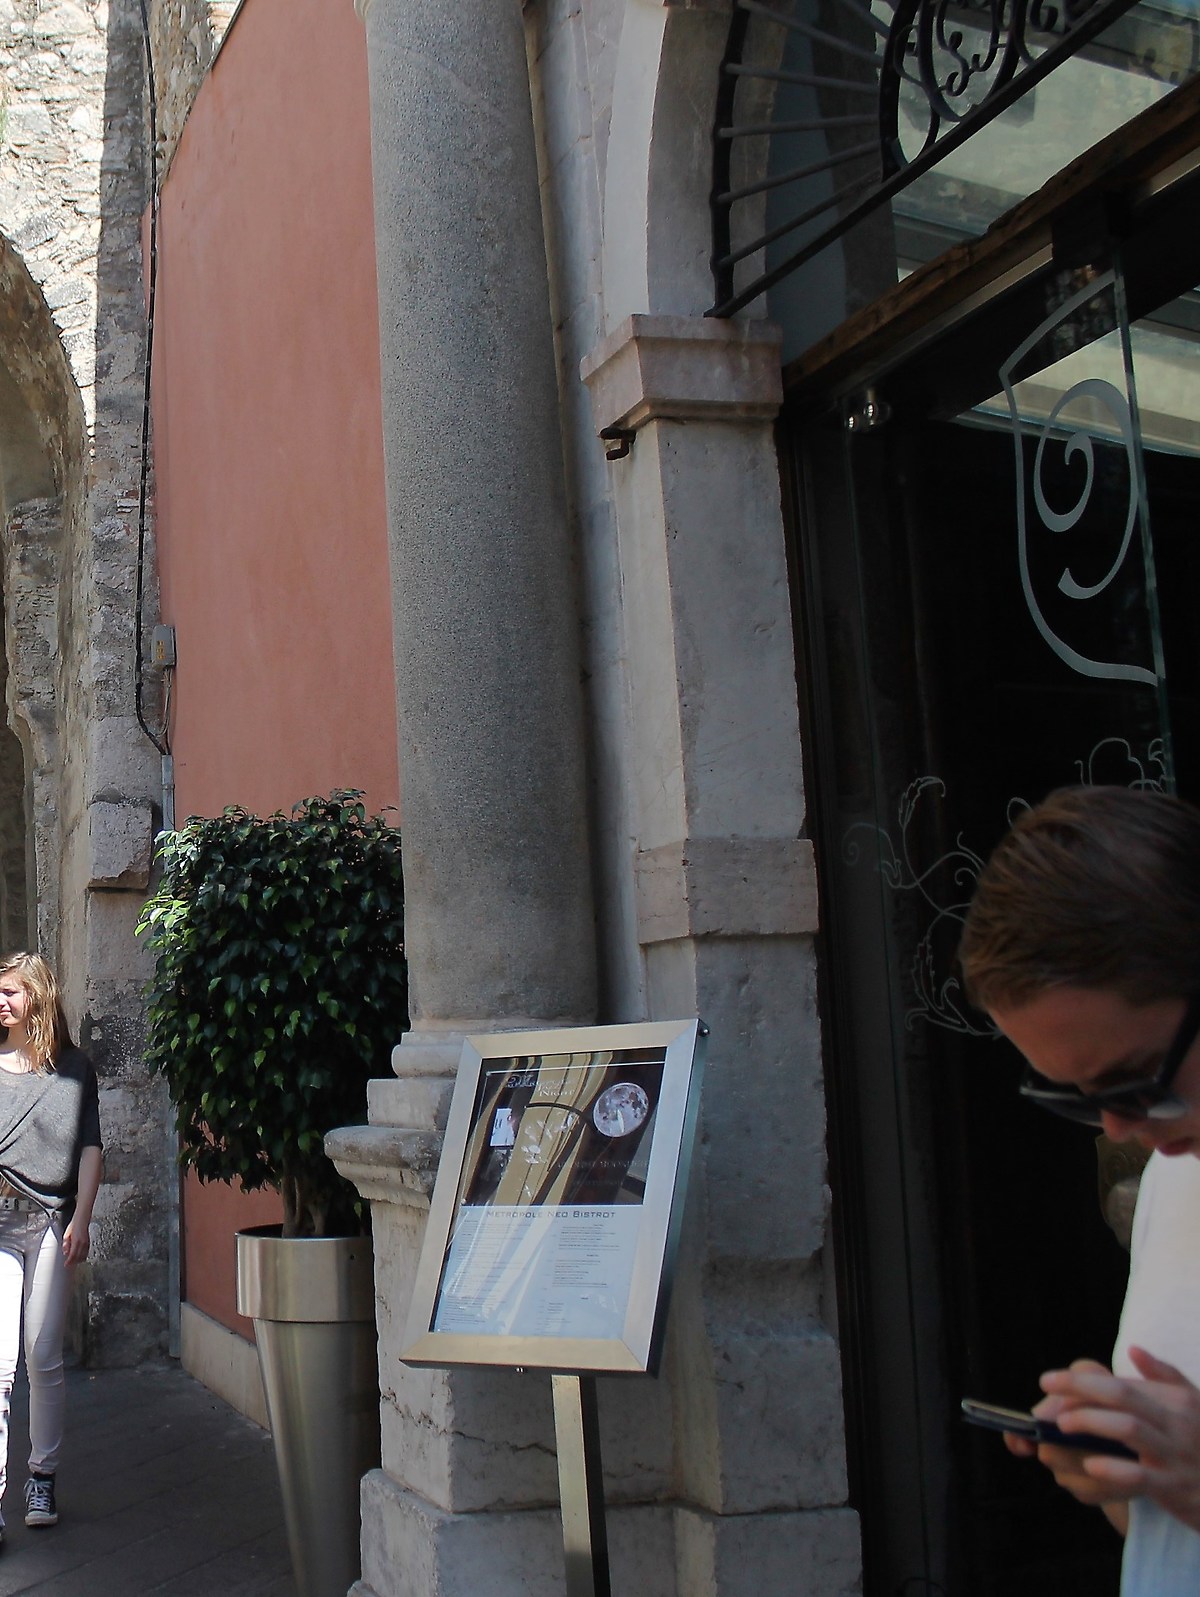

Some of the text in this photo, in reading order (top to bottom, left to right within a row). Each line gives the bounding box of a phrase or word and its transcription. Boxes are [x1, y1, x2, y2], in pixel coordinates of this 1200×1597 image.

[486, 1210, 617, 1219] METROPOLE NEO BISTROT
